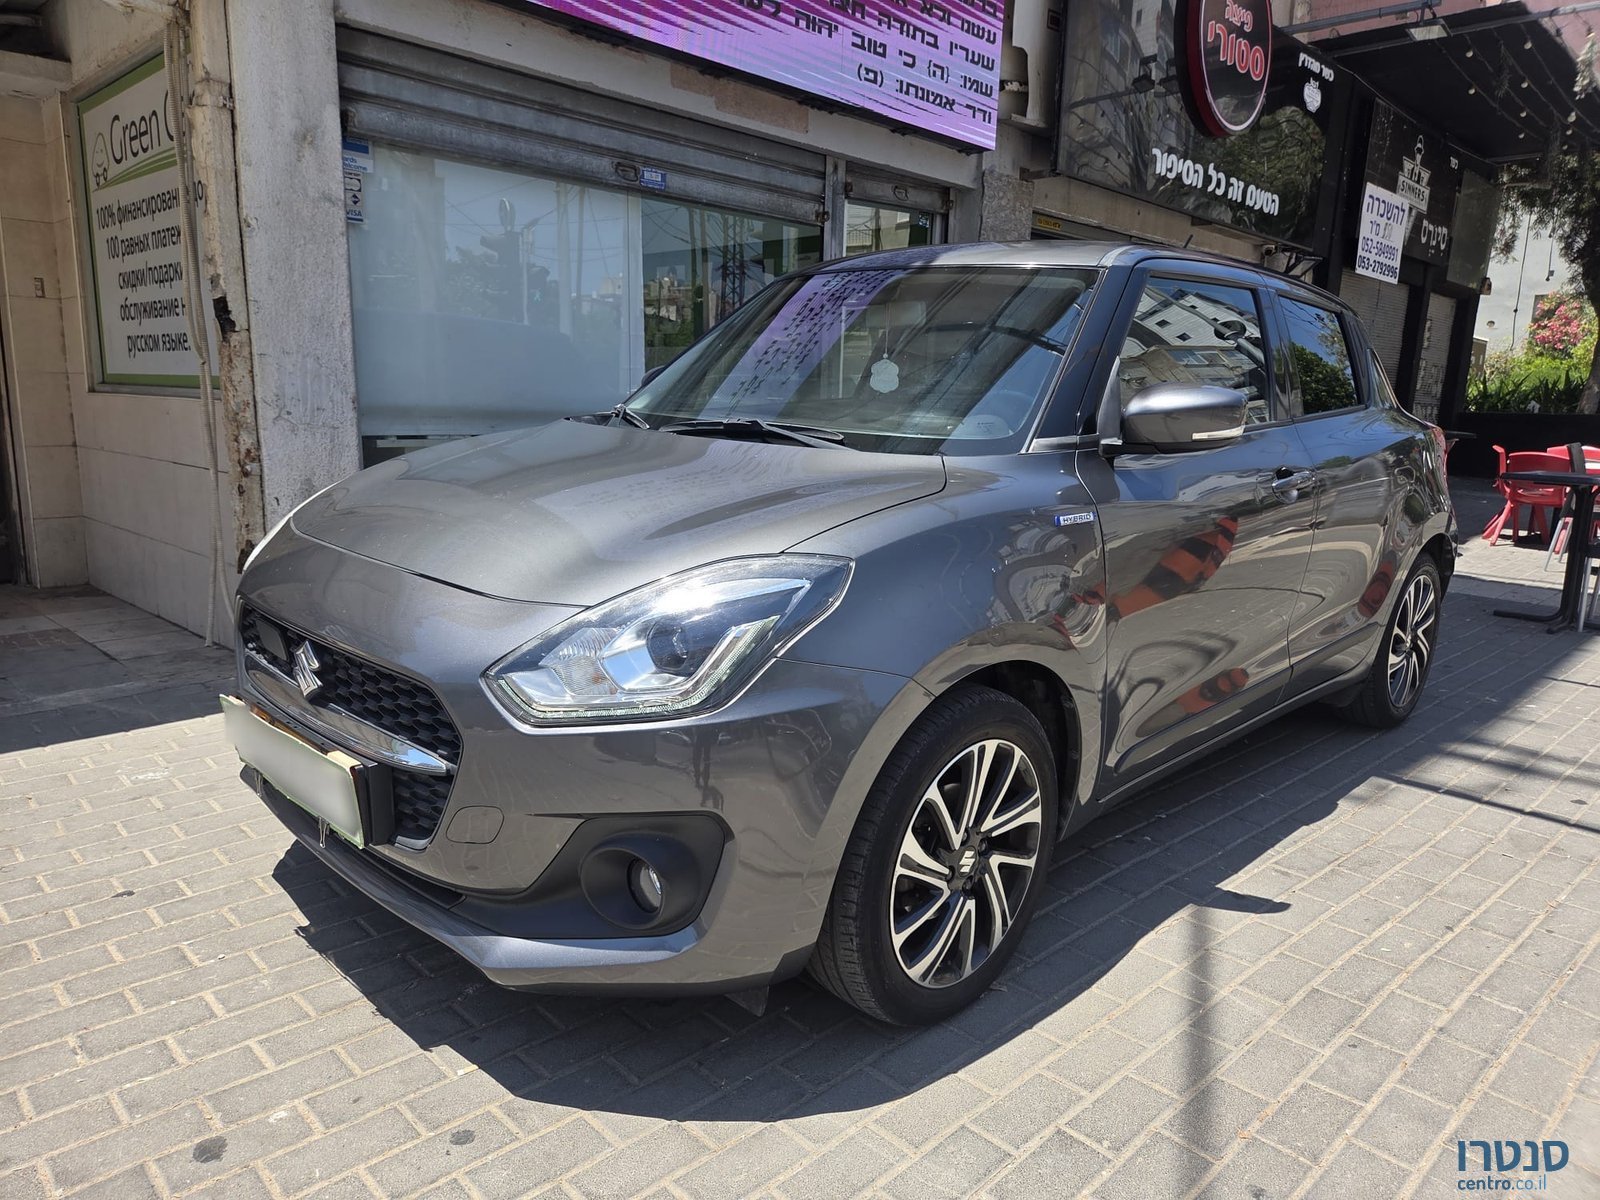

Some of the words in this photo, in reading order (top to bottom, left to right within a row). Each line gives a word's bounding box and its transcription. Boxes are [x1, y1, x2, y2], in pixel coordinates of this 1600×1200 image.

[794, 8, 839, 39] יהוה
[877, 11, 939, 50] בתודה
[961, 17, 997, 45] עשנו
[851, 31, 887, 59] טוב
[898, 49, 916, 69] כי
[1207, 20, 1265, 81] סטורי
[110, 109, 161, 165] Green
[1152, 147, 1204, 189] הסיפור
[1207, 162, 1226, 196] כל
[1227, 177, 1245, 203] זה
[1245, 184, 1280, 217] הטעם
[1400, 180, 1425, 202] SINNERS
[96, 203, 116, 231] 100%
[1366, 193, 1406, 226] להשכרה
[106, 235, 120, 260] 100
[120, 231, 151, 262] равных
[1357, 254, 1398, 279] 053-2792996
[120, 297, 180, 327] обслуживание
[127, 334, 160, 358] русском
[161, 332, 191, 353] языке.
[1062, 514, 1091, 524] HYBRID
